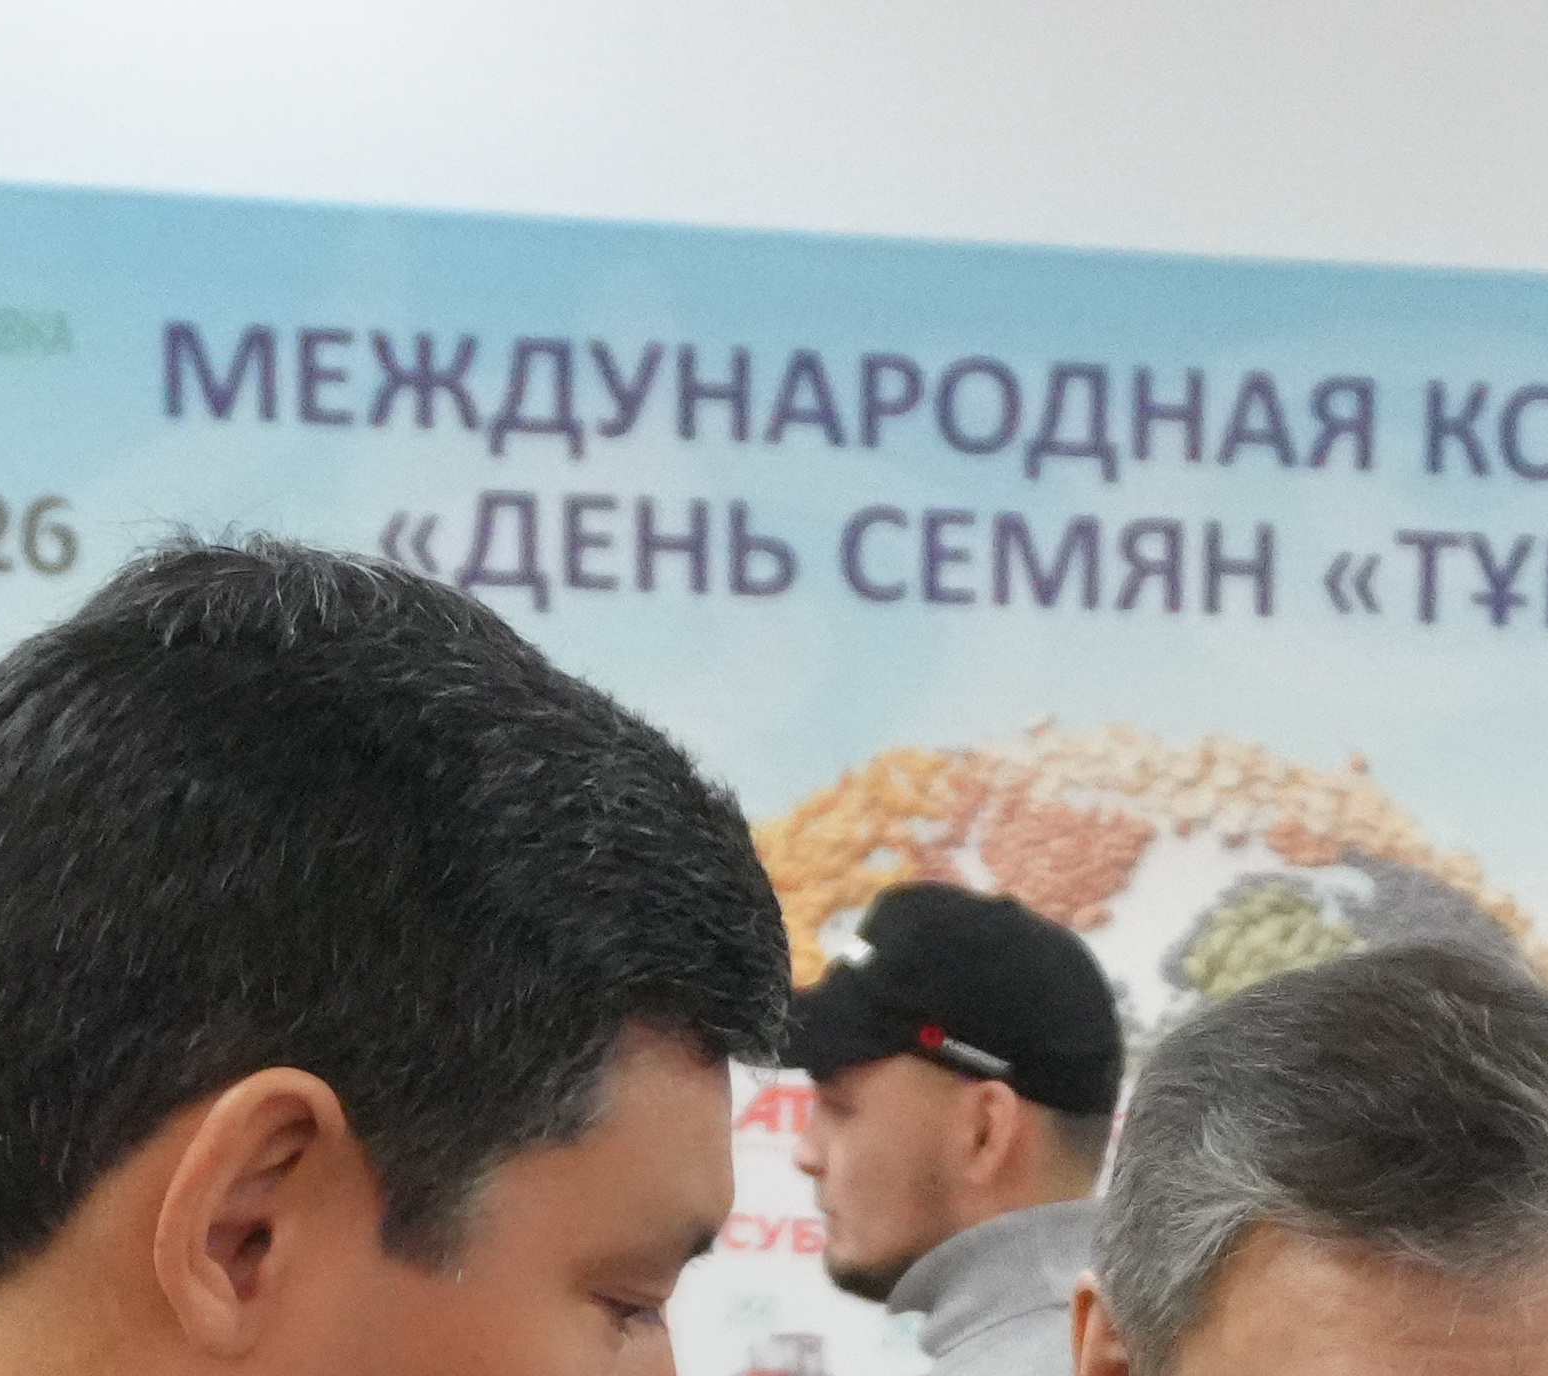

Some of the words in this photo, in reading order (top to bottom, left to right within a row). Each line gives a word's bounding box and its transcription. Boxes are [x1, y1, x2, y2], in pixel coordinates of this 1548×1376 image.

[160, 323, 1377, 478] МЕЖДУНАРОДНАЯ
[380, 491, 798, 606] «ДЕНЬ
[838, 505, 1276, 616] СЕМЯН
[720, 1213, 826, 1254] СУБ
